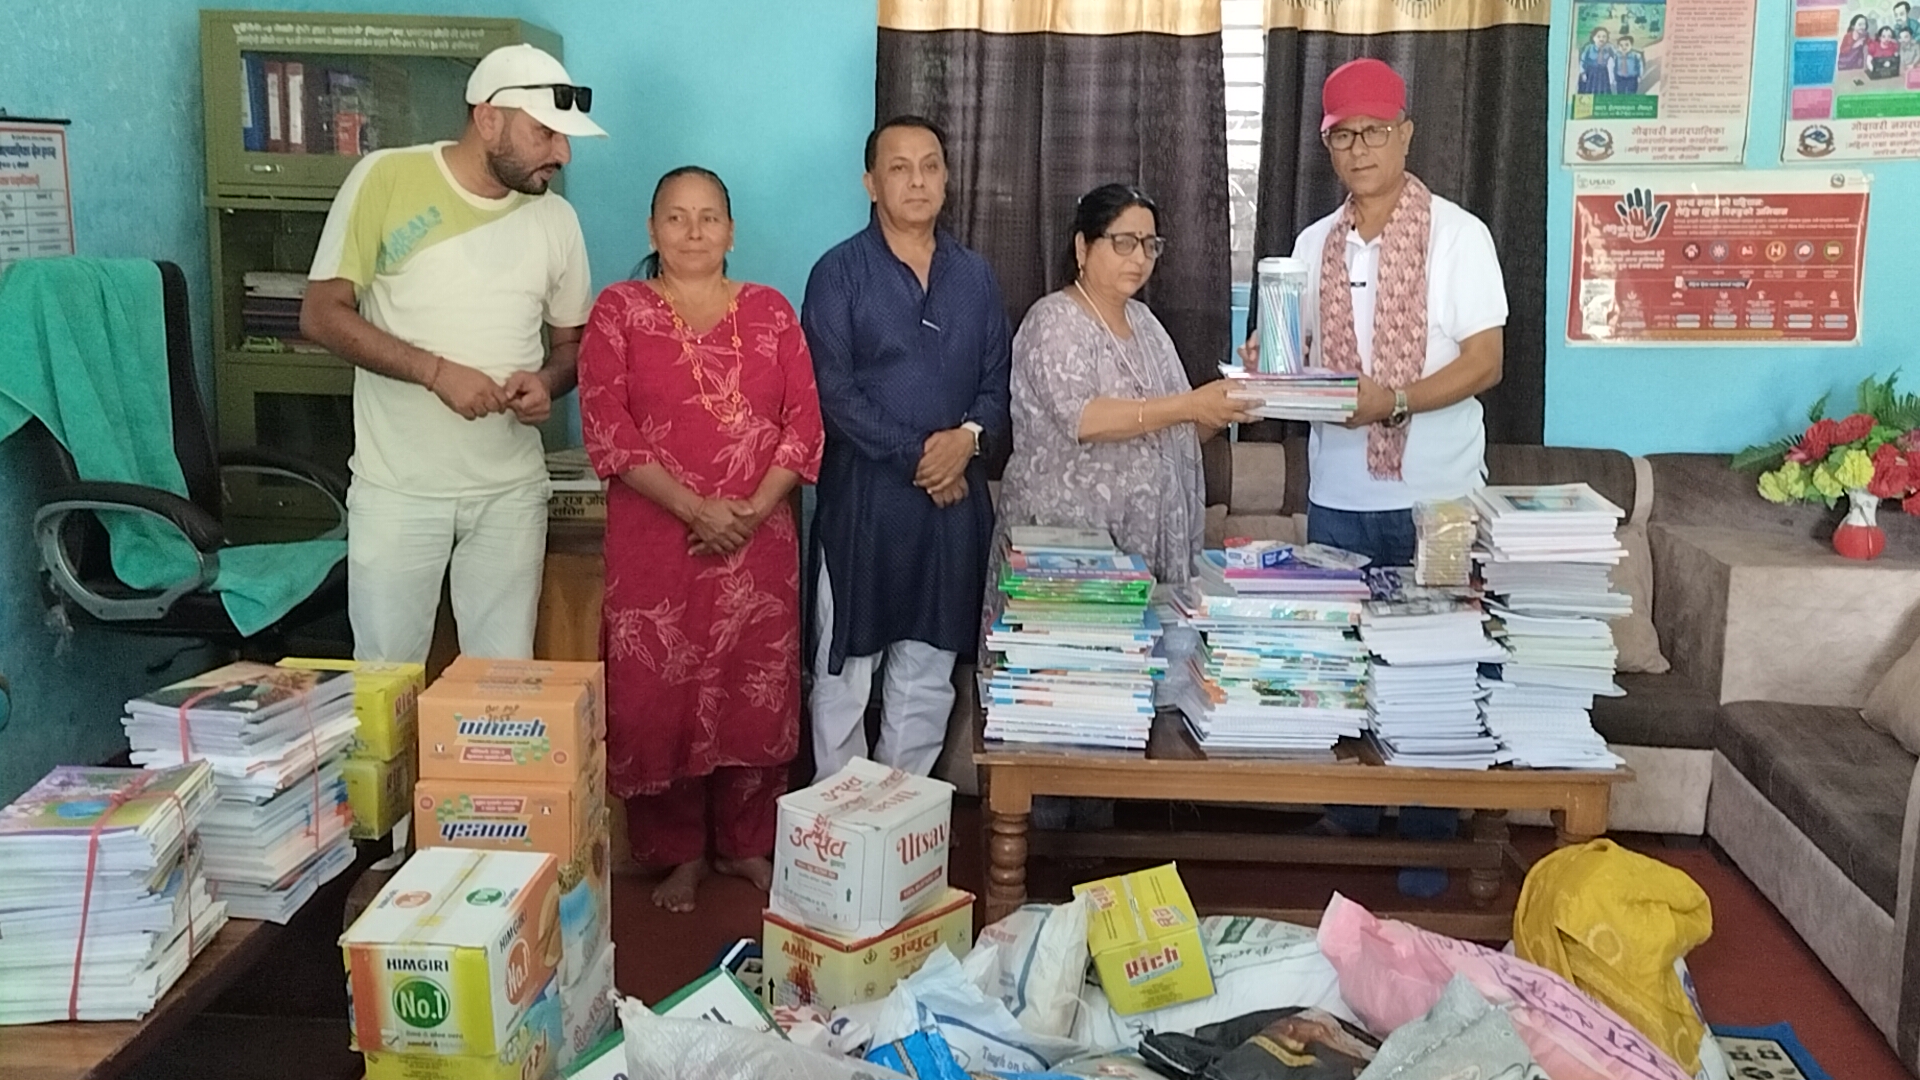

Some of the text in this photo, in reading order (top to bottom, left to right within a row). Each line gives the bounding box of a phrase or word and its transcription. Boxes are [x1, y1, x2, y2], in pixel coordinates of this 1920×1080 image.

[1631, 125, 1725, 136] गोदावरी नगरपालिका
[1850, 120, 1888, 131] गोदावरी
[896, 820, 947, 865] Utsav
[499, 909, 529, 951] HIMGIRI
[387, 958, 449, 972] HIMGIRI
[781, 940, 823, 968] AMRIT
[1125, 946, 1179, 979] Rich
[507, 945, 530, 996] No.1
[400, 989, 445, 1020] No.1
[982, 1045, 1006, 1069] Tough
[1007, 1060, 1019, 1073] on
